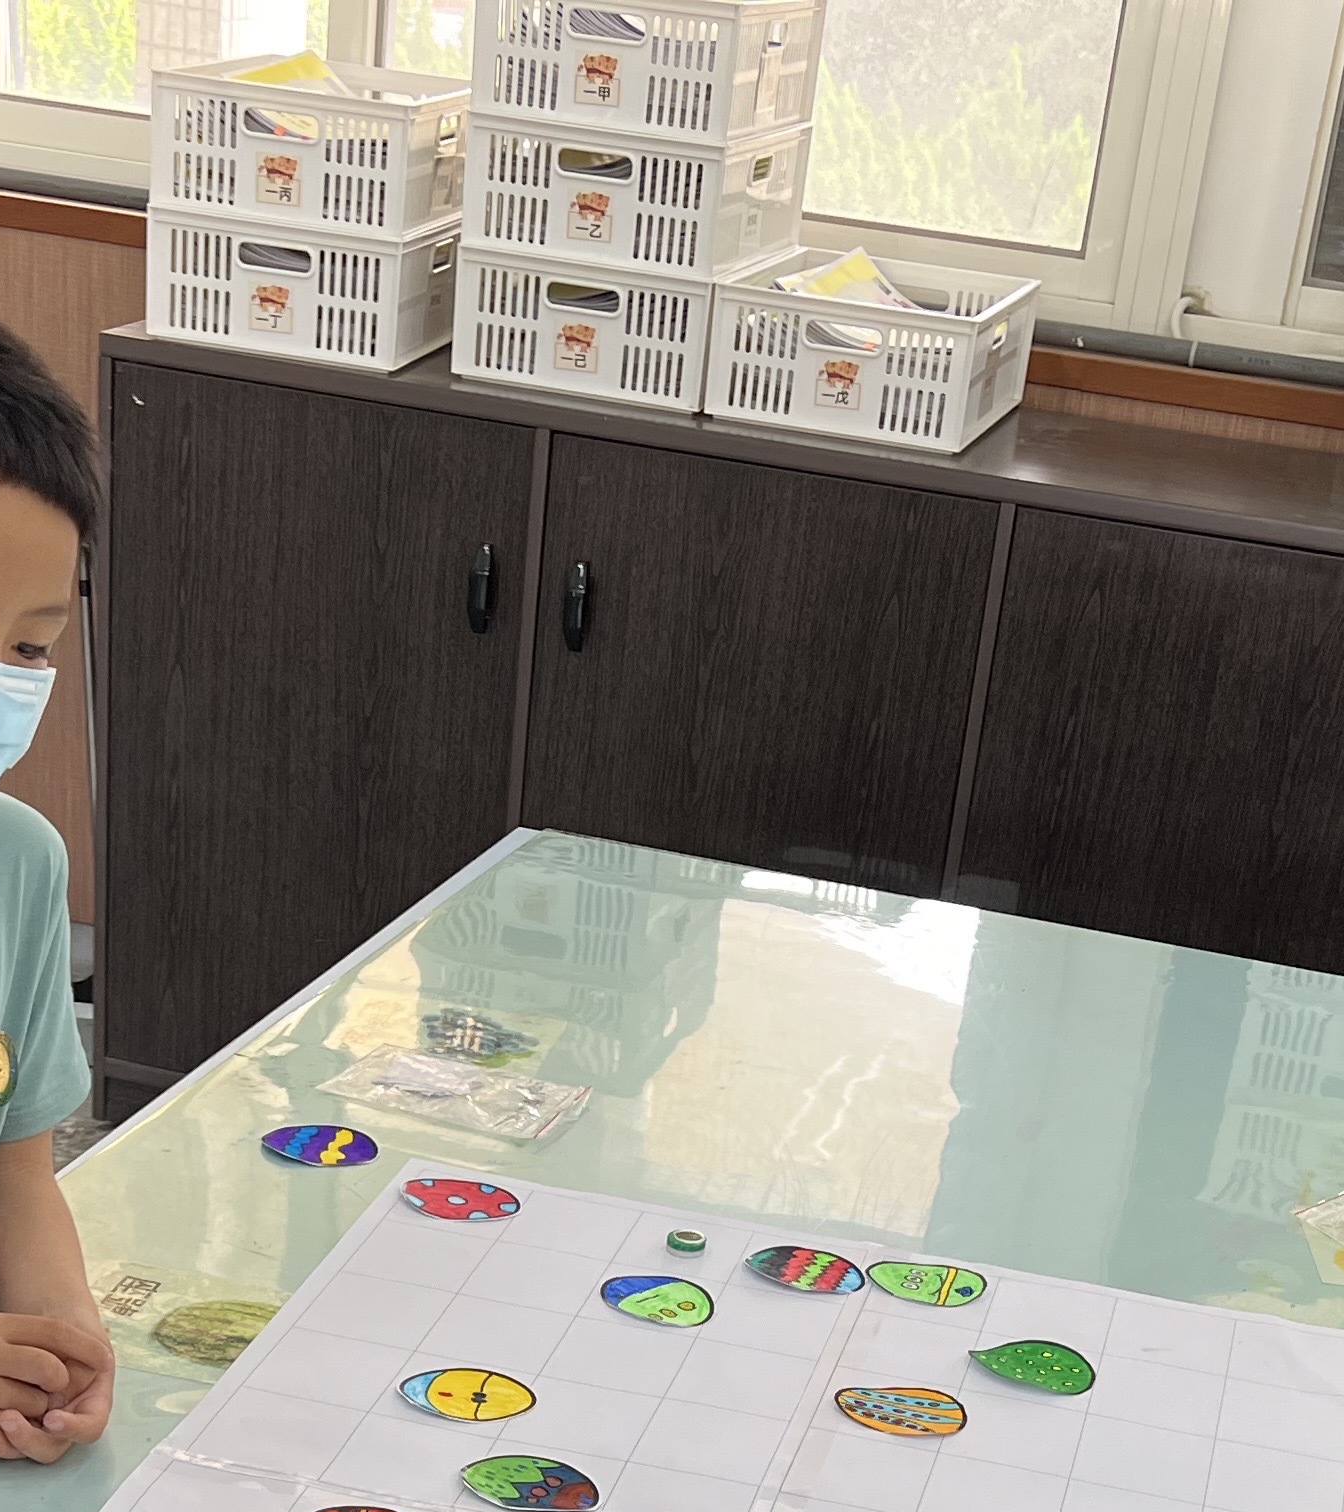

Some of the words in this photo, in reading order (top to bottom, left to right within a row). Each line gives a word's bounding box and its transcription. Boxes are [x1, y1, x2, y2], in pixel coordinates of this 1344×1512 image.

[583, 86, 611, 102] 一甲
[265, 186, 292, 202] 一丙
[575, 223, 602, 239] 一乙
[255, 314, 282, 329] 一丁
